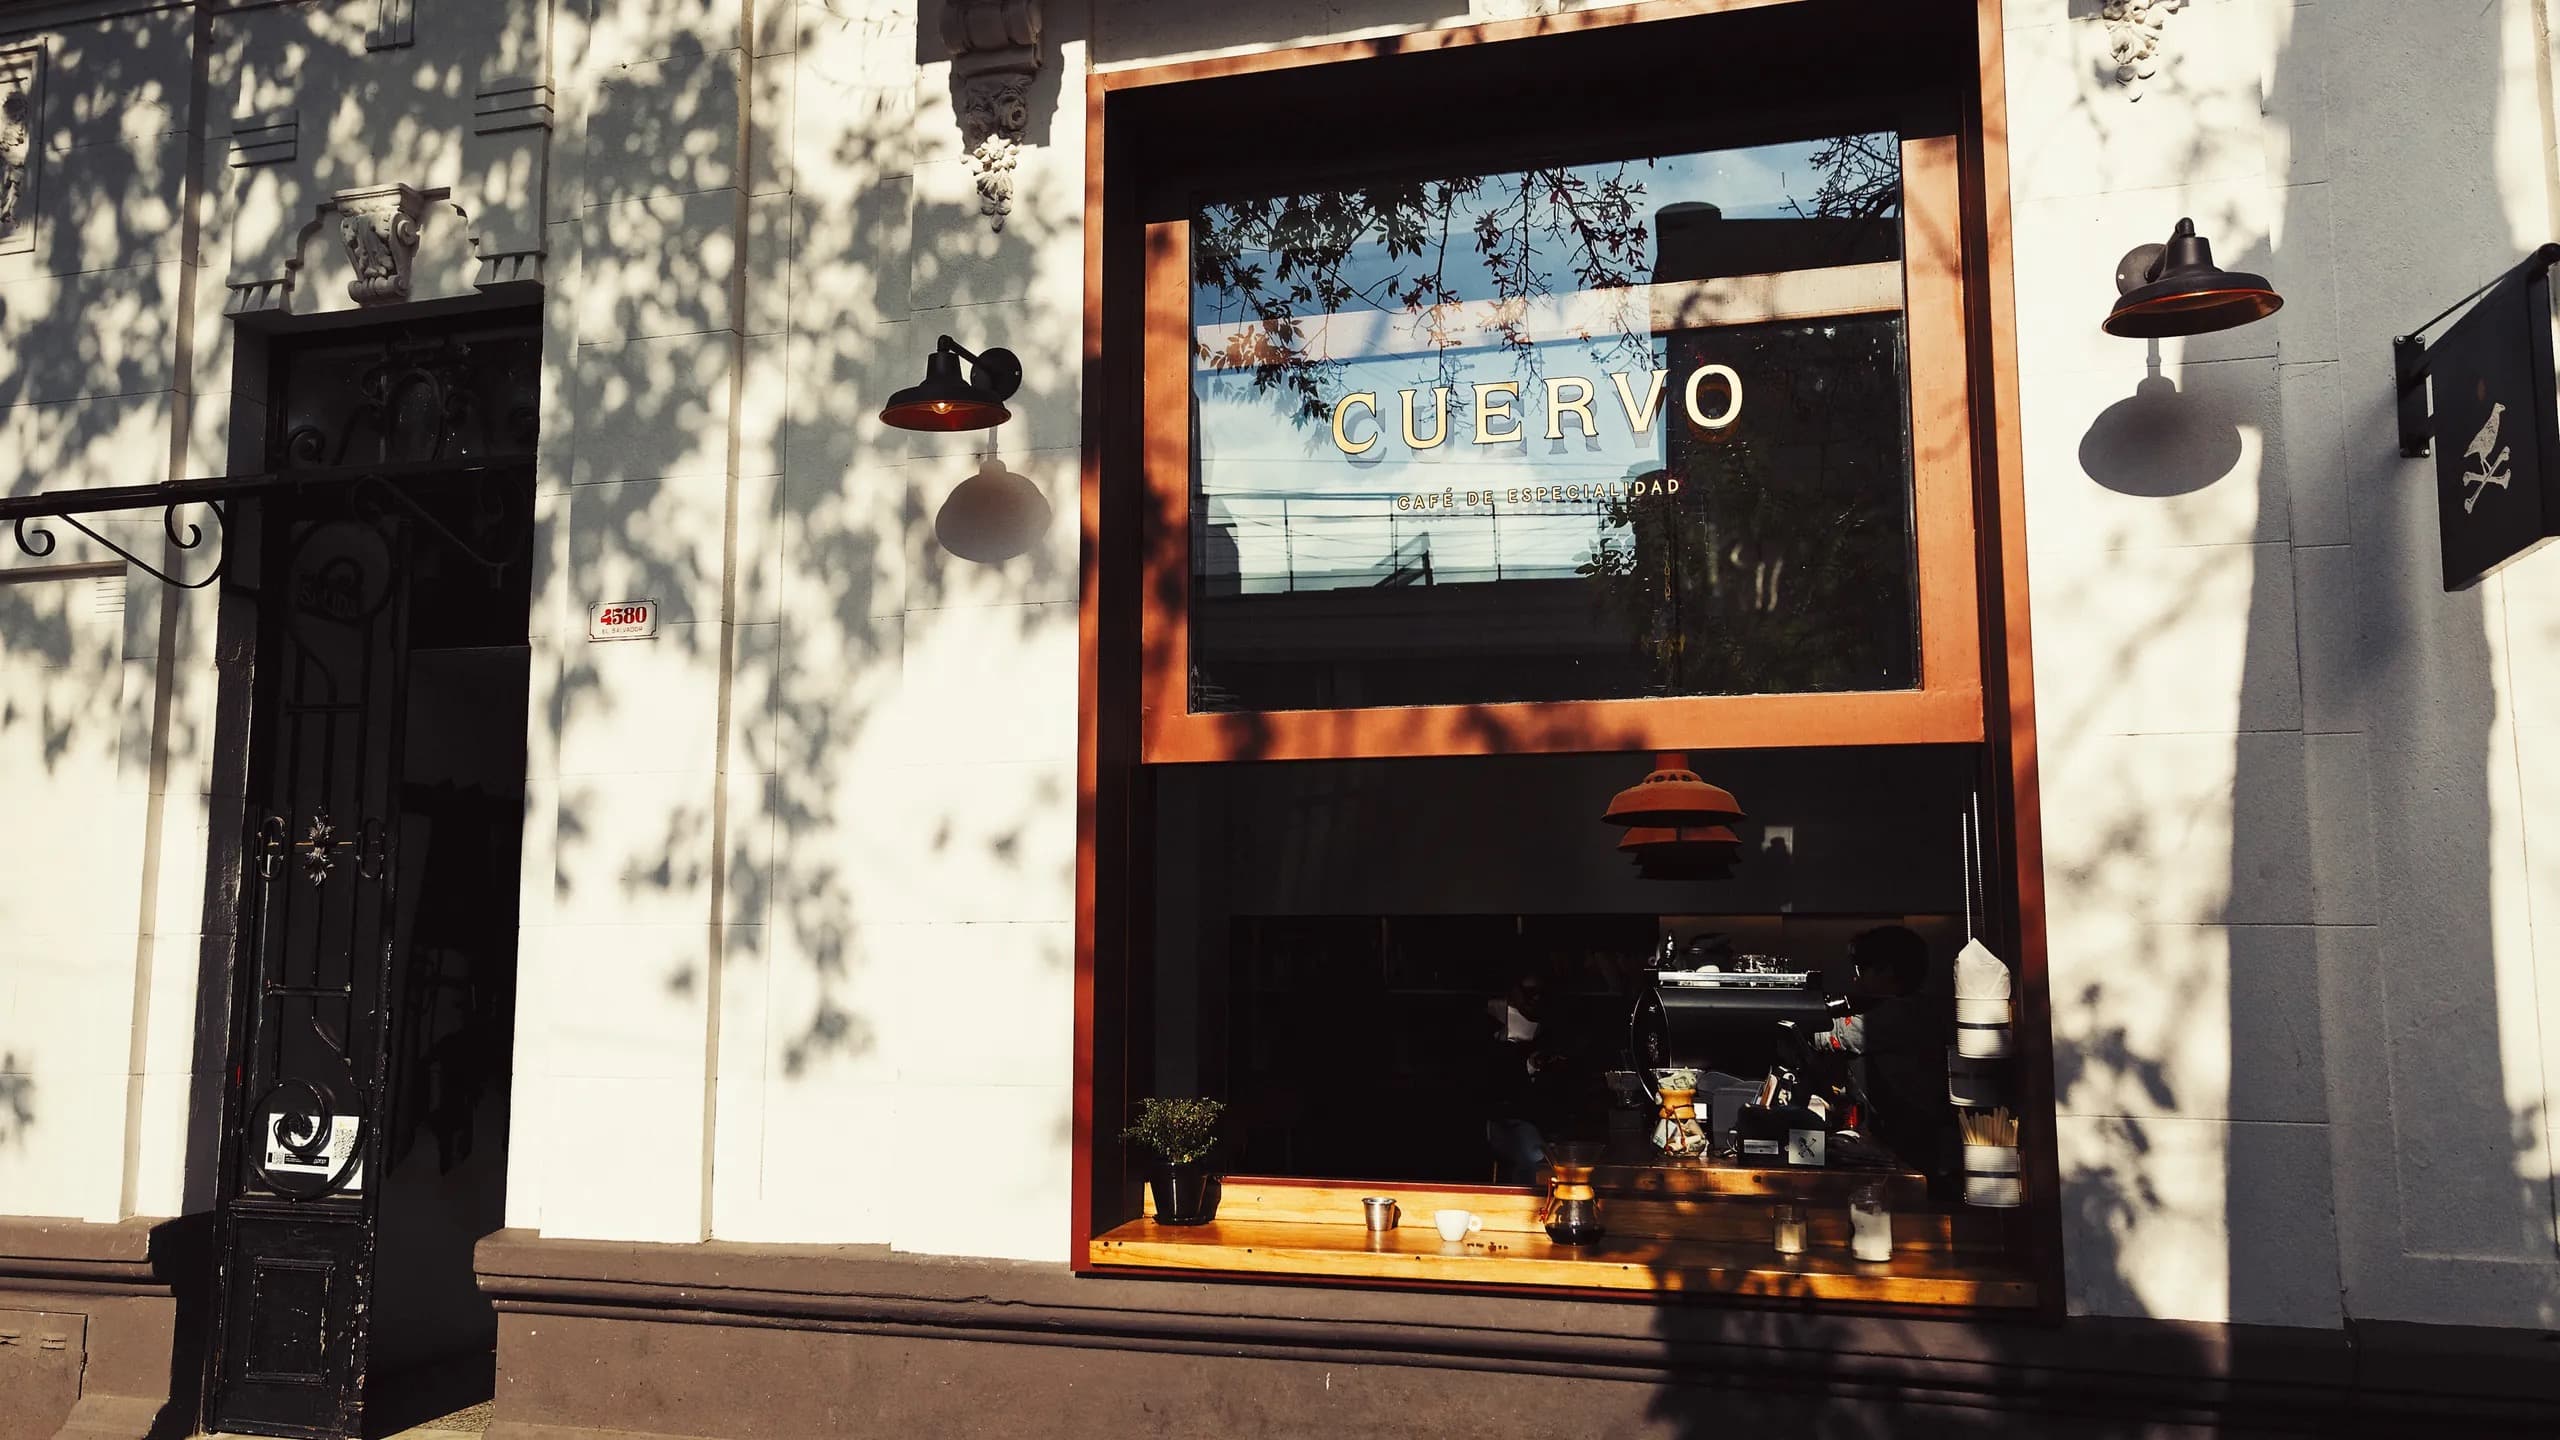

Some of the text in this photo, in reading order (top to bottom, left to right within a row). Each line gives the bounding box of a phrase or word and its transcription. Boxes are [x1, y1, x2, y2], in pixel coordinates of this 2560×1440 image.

[1331, 364, 1743, 454] CUERVO
[1398, 479, 1680, 510] CAFÉ DE ESPECIALIDAD
[600, 606, 647, 625] 4580
